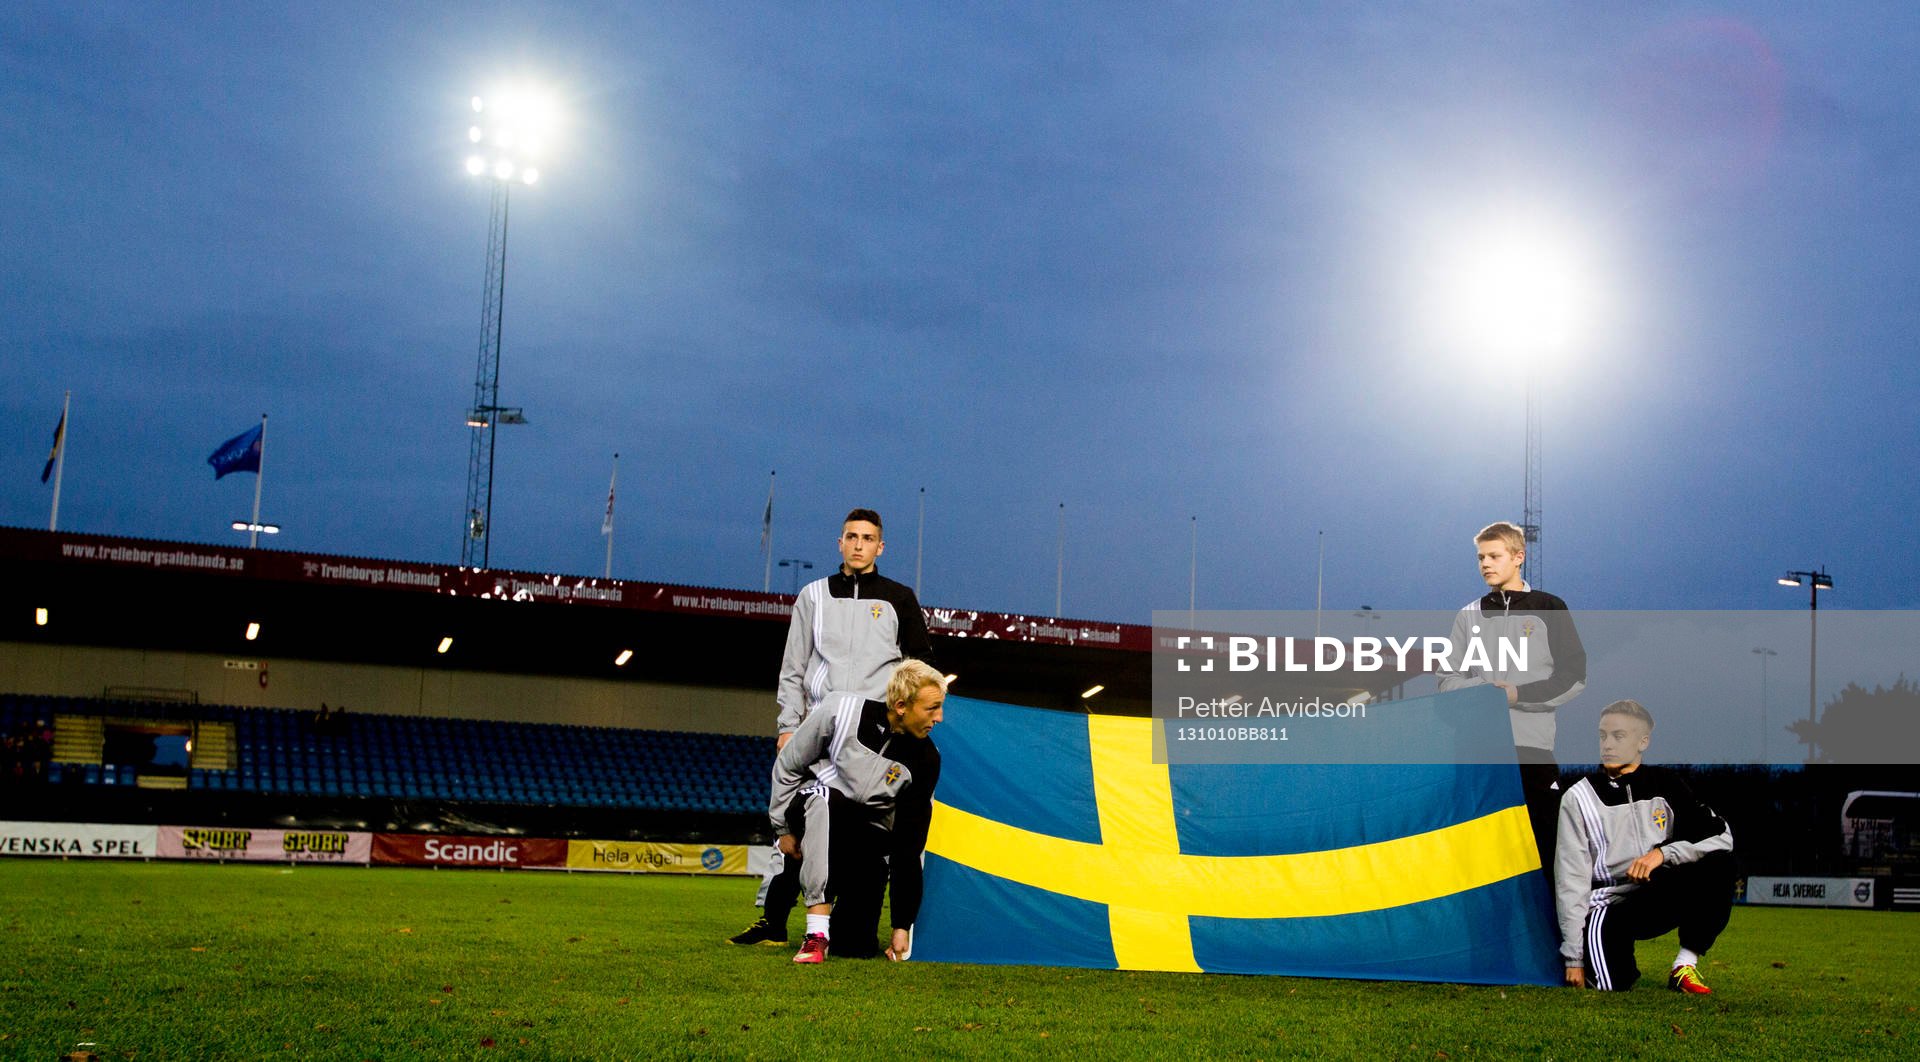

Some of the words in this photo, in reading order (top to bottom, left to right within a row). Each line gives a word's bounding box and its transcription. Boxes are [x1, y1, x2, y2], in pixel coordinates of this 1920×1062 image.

[62, 543, 244, 571] www.trelleborgsallehanda.se
[321, 563, 384, 584] Trelleborgs
[387, 568, 440, 587] Allehanda
[92, 839, 143, 855] SPEL
[183, 829, 252, 850] SPORT
[283, 831, 349, 854] SPORT
[424, 839, 518, 863] Scandic
[594, 847, 629, 864] Hela
[635, 849, 683, 868] vägen
[1773, 883, 1790, 898] HEJA
